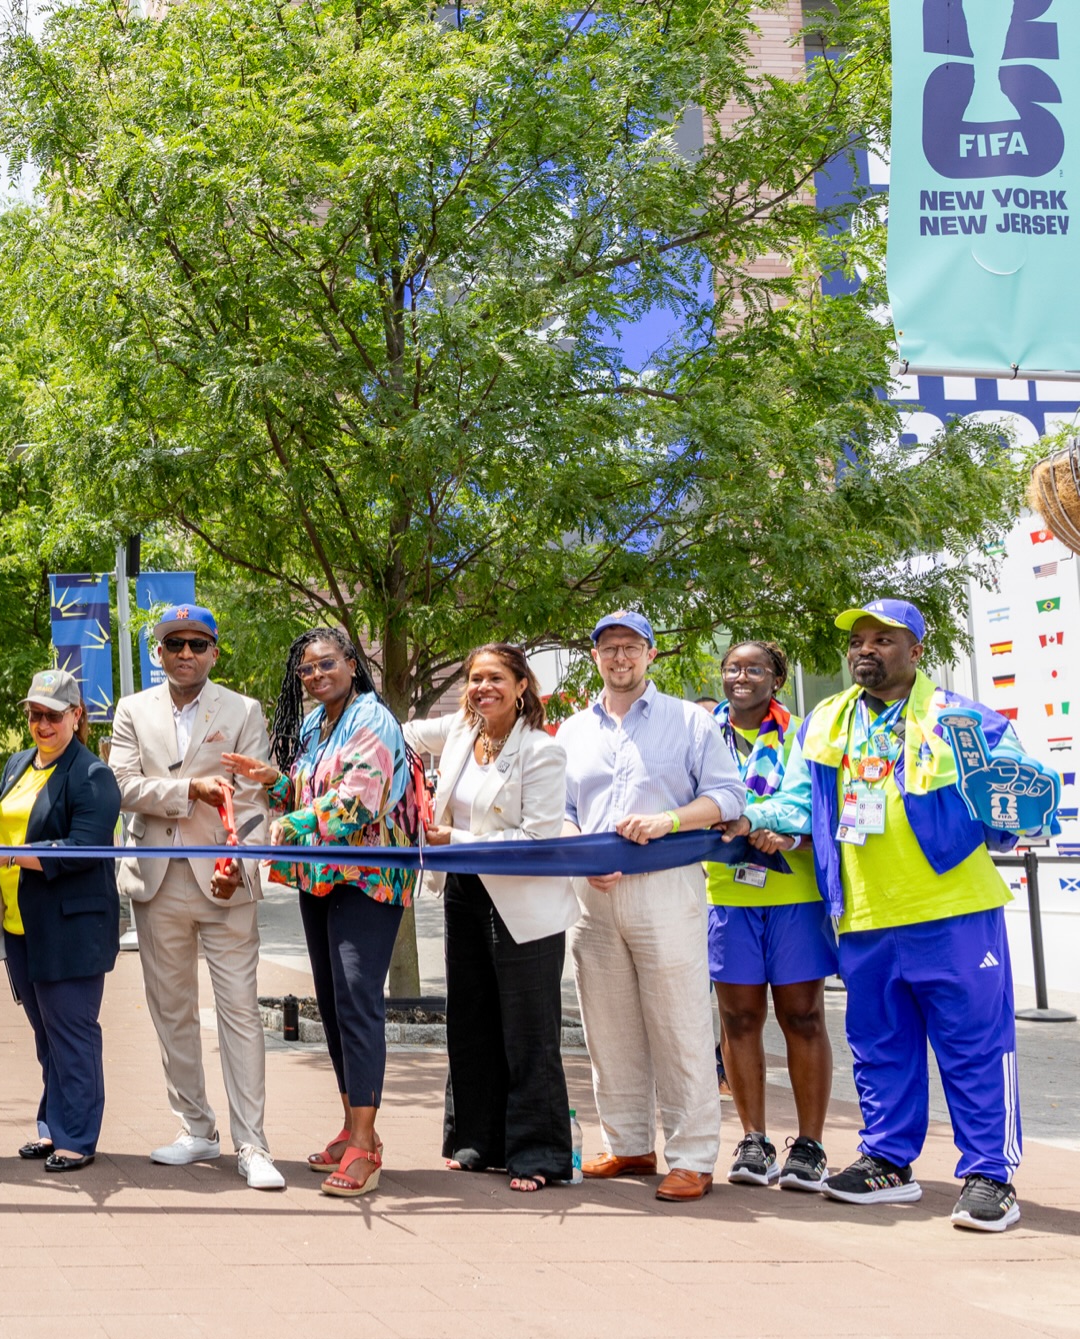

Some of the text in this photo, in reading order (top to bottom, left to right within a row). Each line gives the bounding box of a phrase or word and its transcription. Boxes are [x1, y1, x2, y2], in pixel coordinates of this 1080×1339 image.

[959, 131, 1029, 158] FIFA
[920, 188, 1068, 211] NEW YORK
[920, 213, 1069, 236] NEW JERSEY
[962, 751, 980, 767] ME
